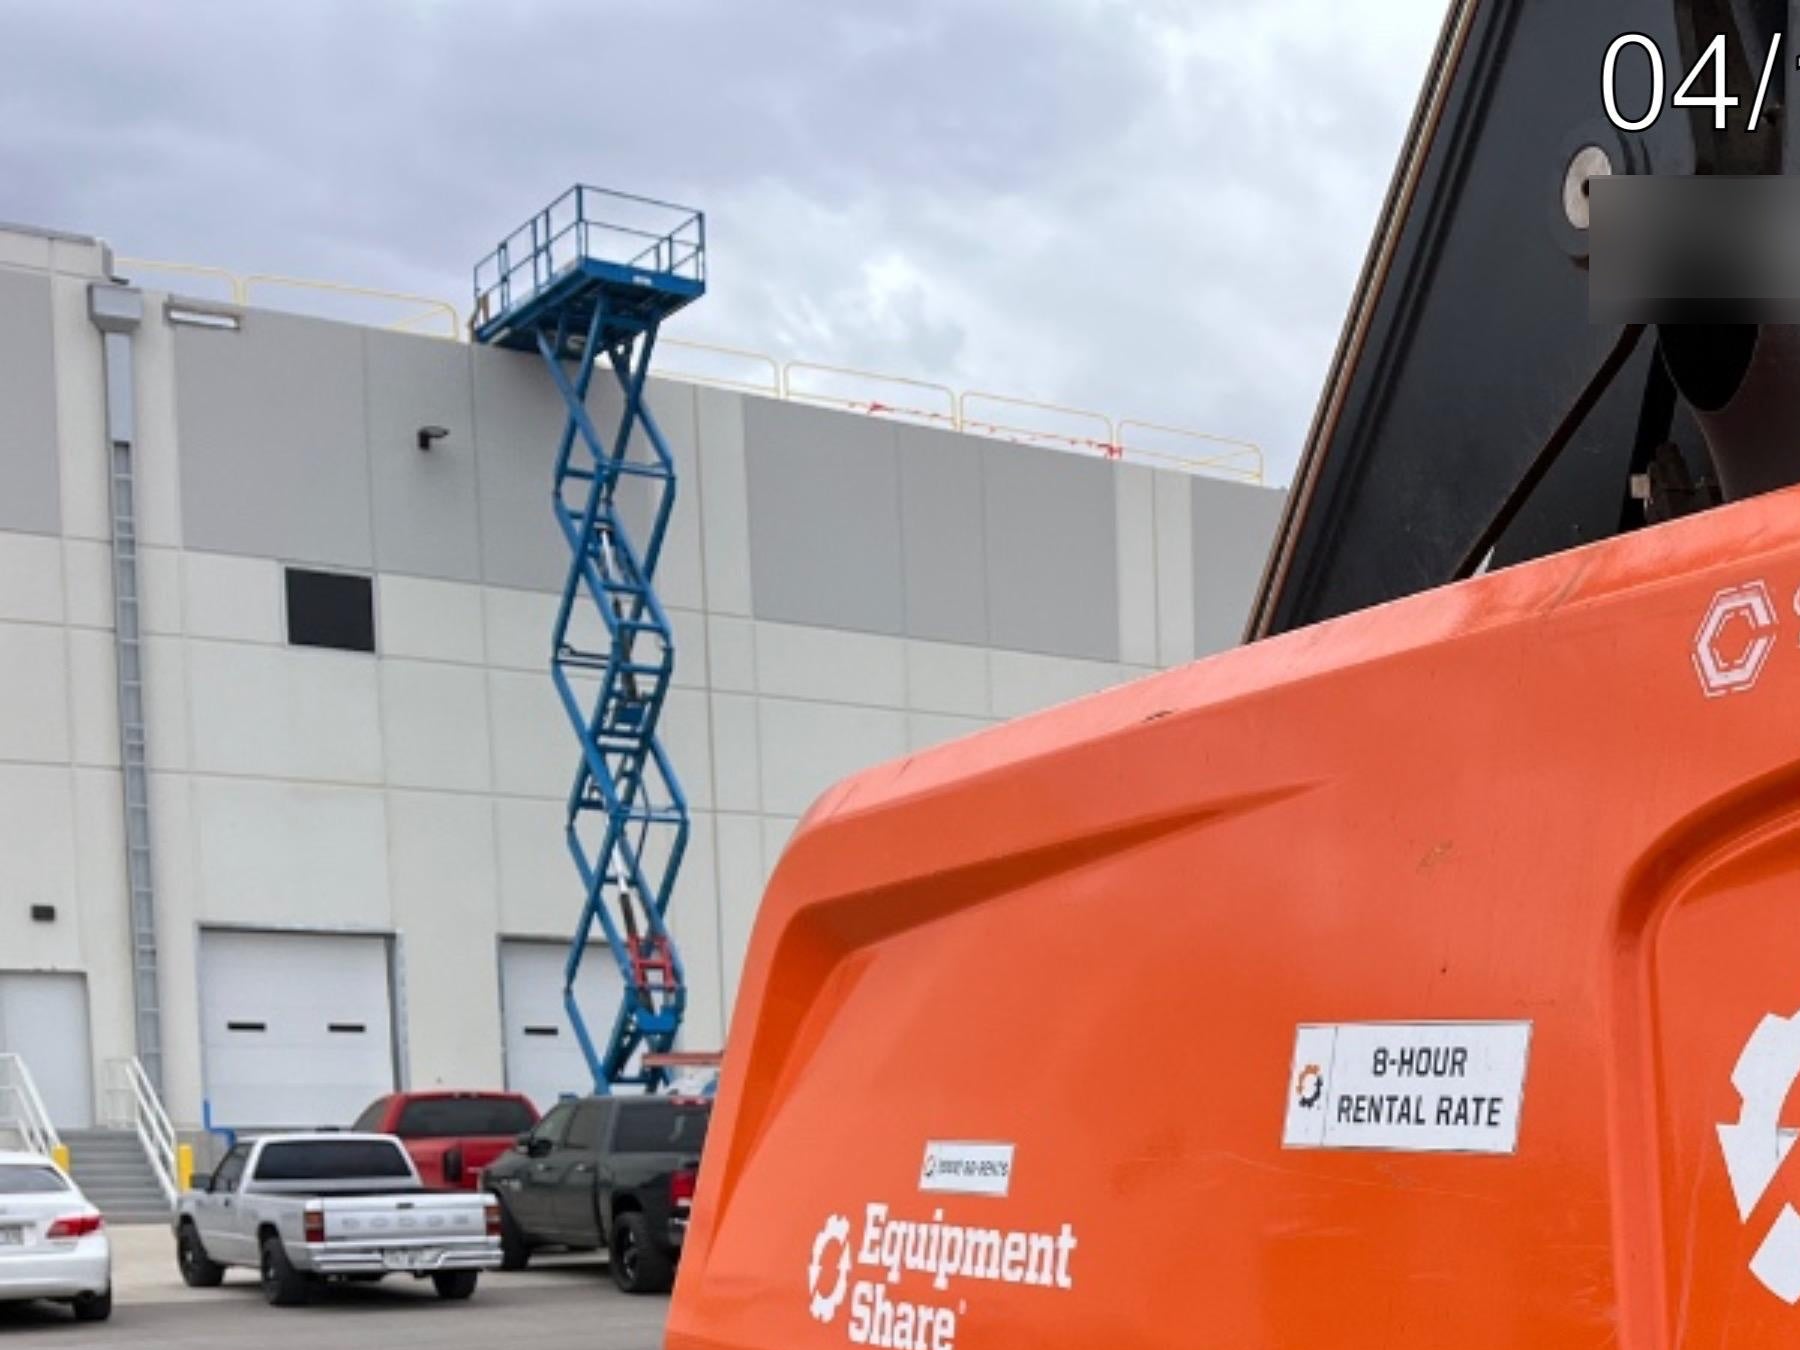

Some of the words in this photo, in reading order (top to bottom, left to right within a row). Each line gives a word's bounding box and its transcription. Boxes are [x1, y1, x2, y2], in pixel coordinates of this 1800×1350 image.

[1372, 1047, 1468, 1077] 8-HOUR
[1337, 1095, 1426, 1126] RENTAL
[1436, 1097, 1503, 1127] RATE
[857, 1202, 1077, 1290] Equipment
